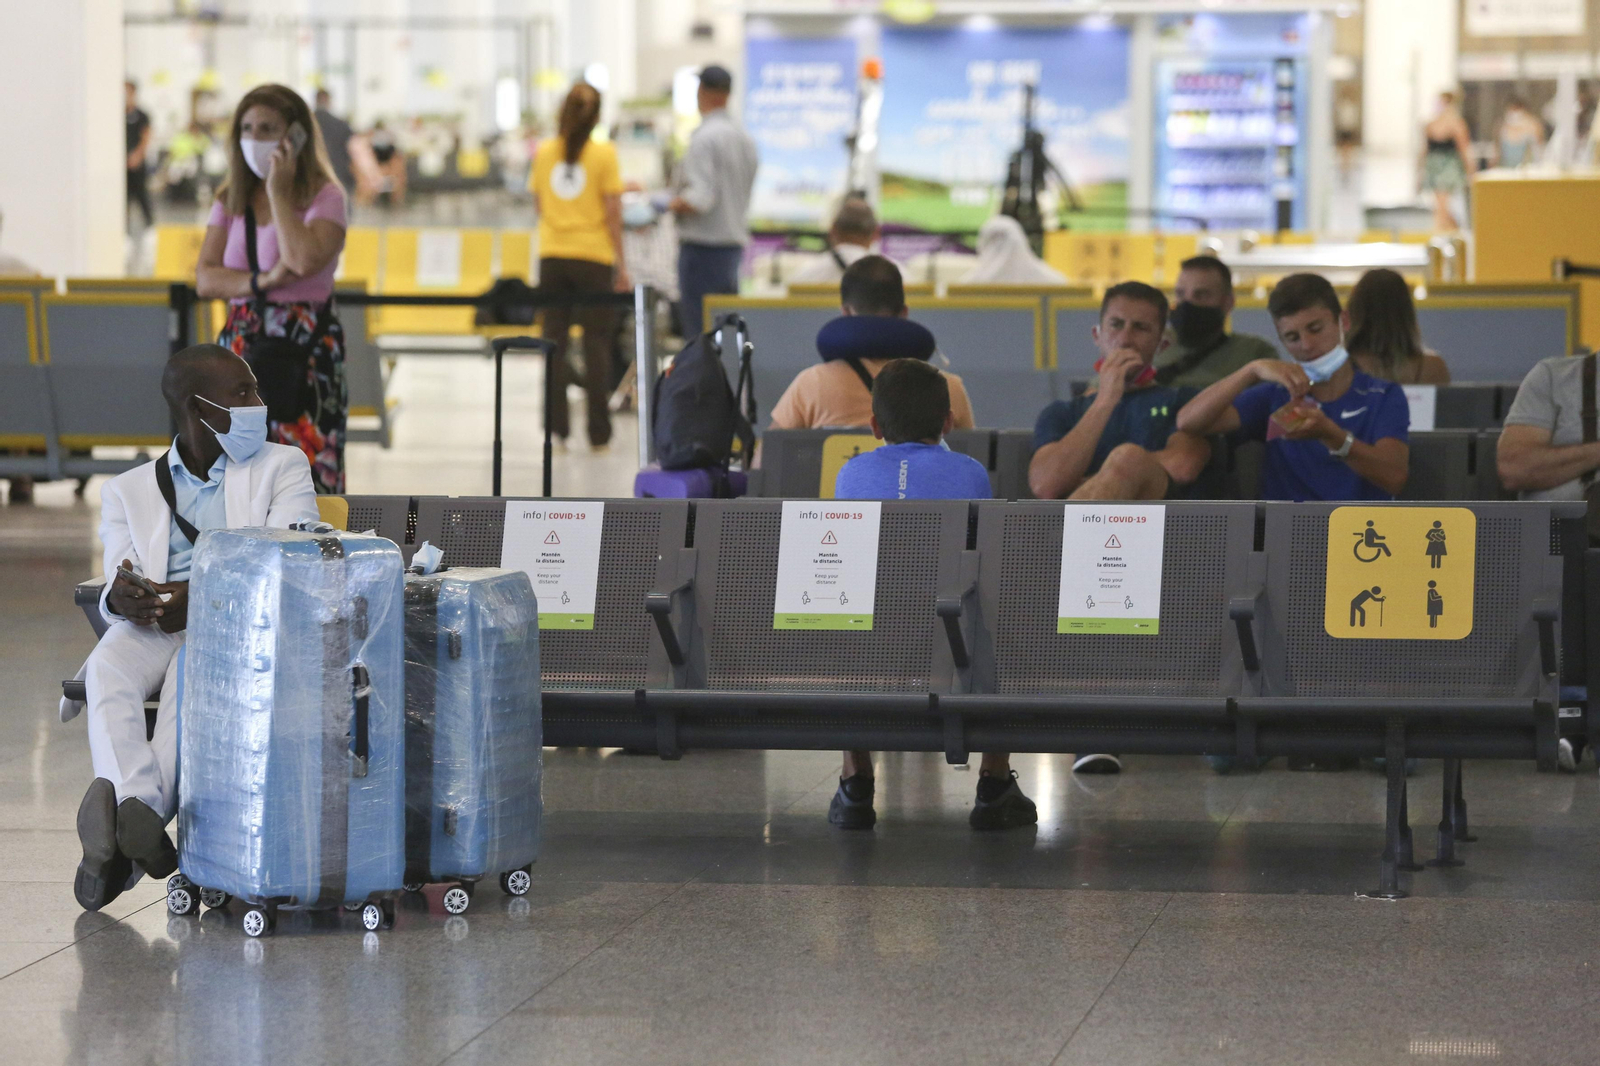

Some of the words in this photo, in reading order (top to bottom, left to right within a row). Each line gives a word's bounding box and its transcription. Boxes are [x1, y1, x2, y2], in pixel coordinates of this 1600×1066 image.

[898, 460, 908, 490] UNDER
[522, 511, 542, 519] info
[799, 511, 818, 519] info
[1082, 514, 1101, 523] info
